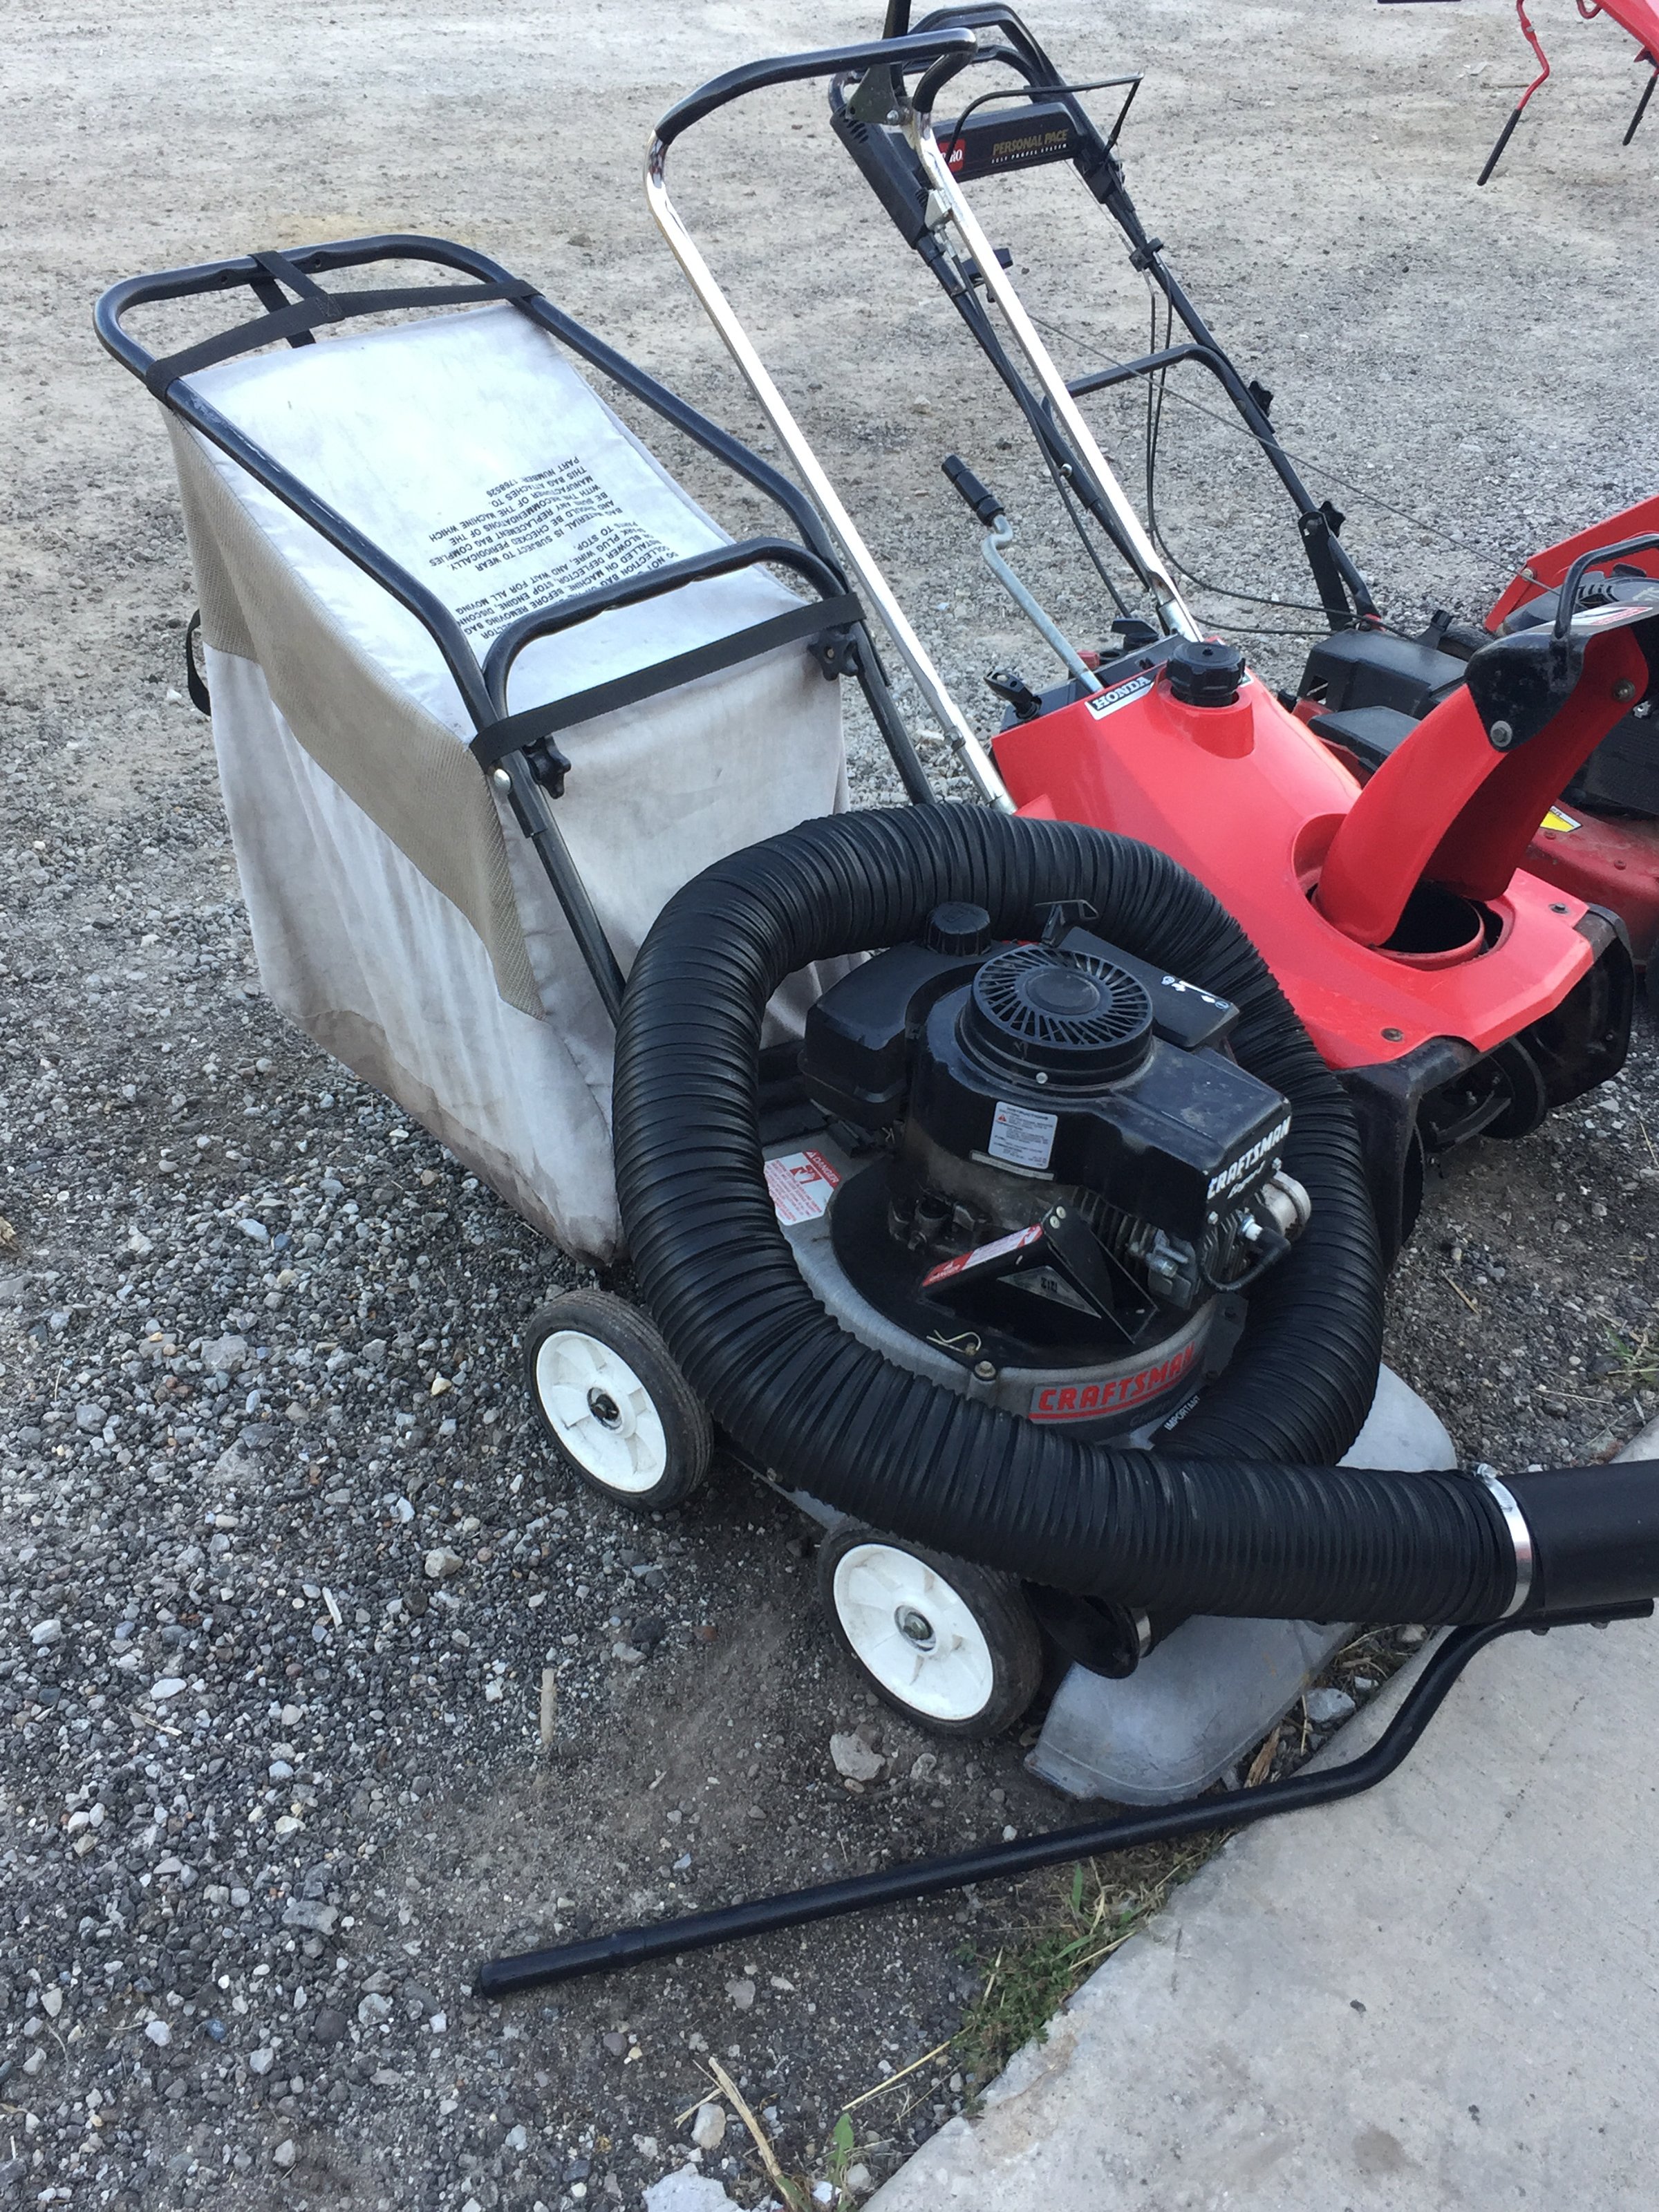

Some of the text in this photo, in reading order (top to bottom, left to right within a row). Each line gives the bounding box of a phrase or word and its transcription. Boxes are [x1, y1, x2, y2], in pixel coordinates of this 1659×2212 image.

[992, 129, 1069, 156] PERSONAL PACE
[557, 456, 579, 473] PART
[566, 465, 587, 480] THIS
[486, 479, 518, 497] 1768526
[546, 476, 565, 487] BAG
[504, 482, 545, 500] ATTACHES
[578, 484, 601, 496] WITH
[594, 491, 608, 502] BE
[517, 496, 529, 508] OF
[555, 501, 571, 512] ANY
[597, 499, 614, 509] AND
[496, 505, 516, 517] THE
[604, 507, 623, 516] BAG
[459, 512, 496, 529] MACHINE
[494, 507, 554, 539] REPLACEMENT
[550, 514, 564, 526] BE
[428, 525, 459, 542] WHICH
[470, 528, 481, 538] OF
[510, 524, 549, 545] CHECKED
[553, 527, 564, 538] IS
[600, 525, 614, 536] TO
[448, 533, 468, 546] THE
[473, 535, 494, 547] BAG
[516, 535, 553, 555] SUBJECT
[573, 534, 599, 551] STOP.
[595, 533, 620, 552] PLUG
[605, 534, 641, 559] BLOWER
[429, 543, 473, 566] COMPLIES
[502, 550, 516, 560] TO
[569, 550, 596, 565] WIRE,
[474, 556, 502, 572] WEAR
[550, 563, 568, 575] AND
[604, 561, 619, 572] ON
[529, 572, 551, 584] WAIT
[599, 572, 619, 585] BAG
[508, 580, 528, 593] FOR
[532, 581, 554, 595] STOP
[489, 590, 507, 601] ALL
[494, 592, 530, 610] ENGINE,
[529, 588, 564, 609] BEFORE
[455, 597, 489, 615] MOVING
[456, 607, 495, 626] DISCONN
[485, 605, 529, 626] REMOVING
[463, 621, 485, 635] BAG
[1092, 676, 1151, 710] HONDA
[1208, 1115, 1291, 1199] CRAFTSMAN
[812, 1157, 839, 1183] DANGER
[1038, 1341, 1196, 1412] CRAFTSMAN
[1163, 1394, 1201, 1431] IMPORTANT
